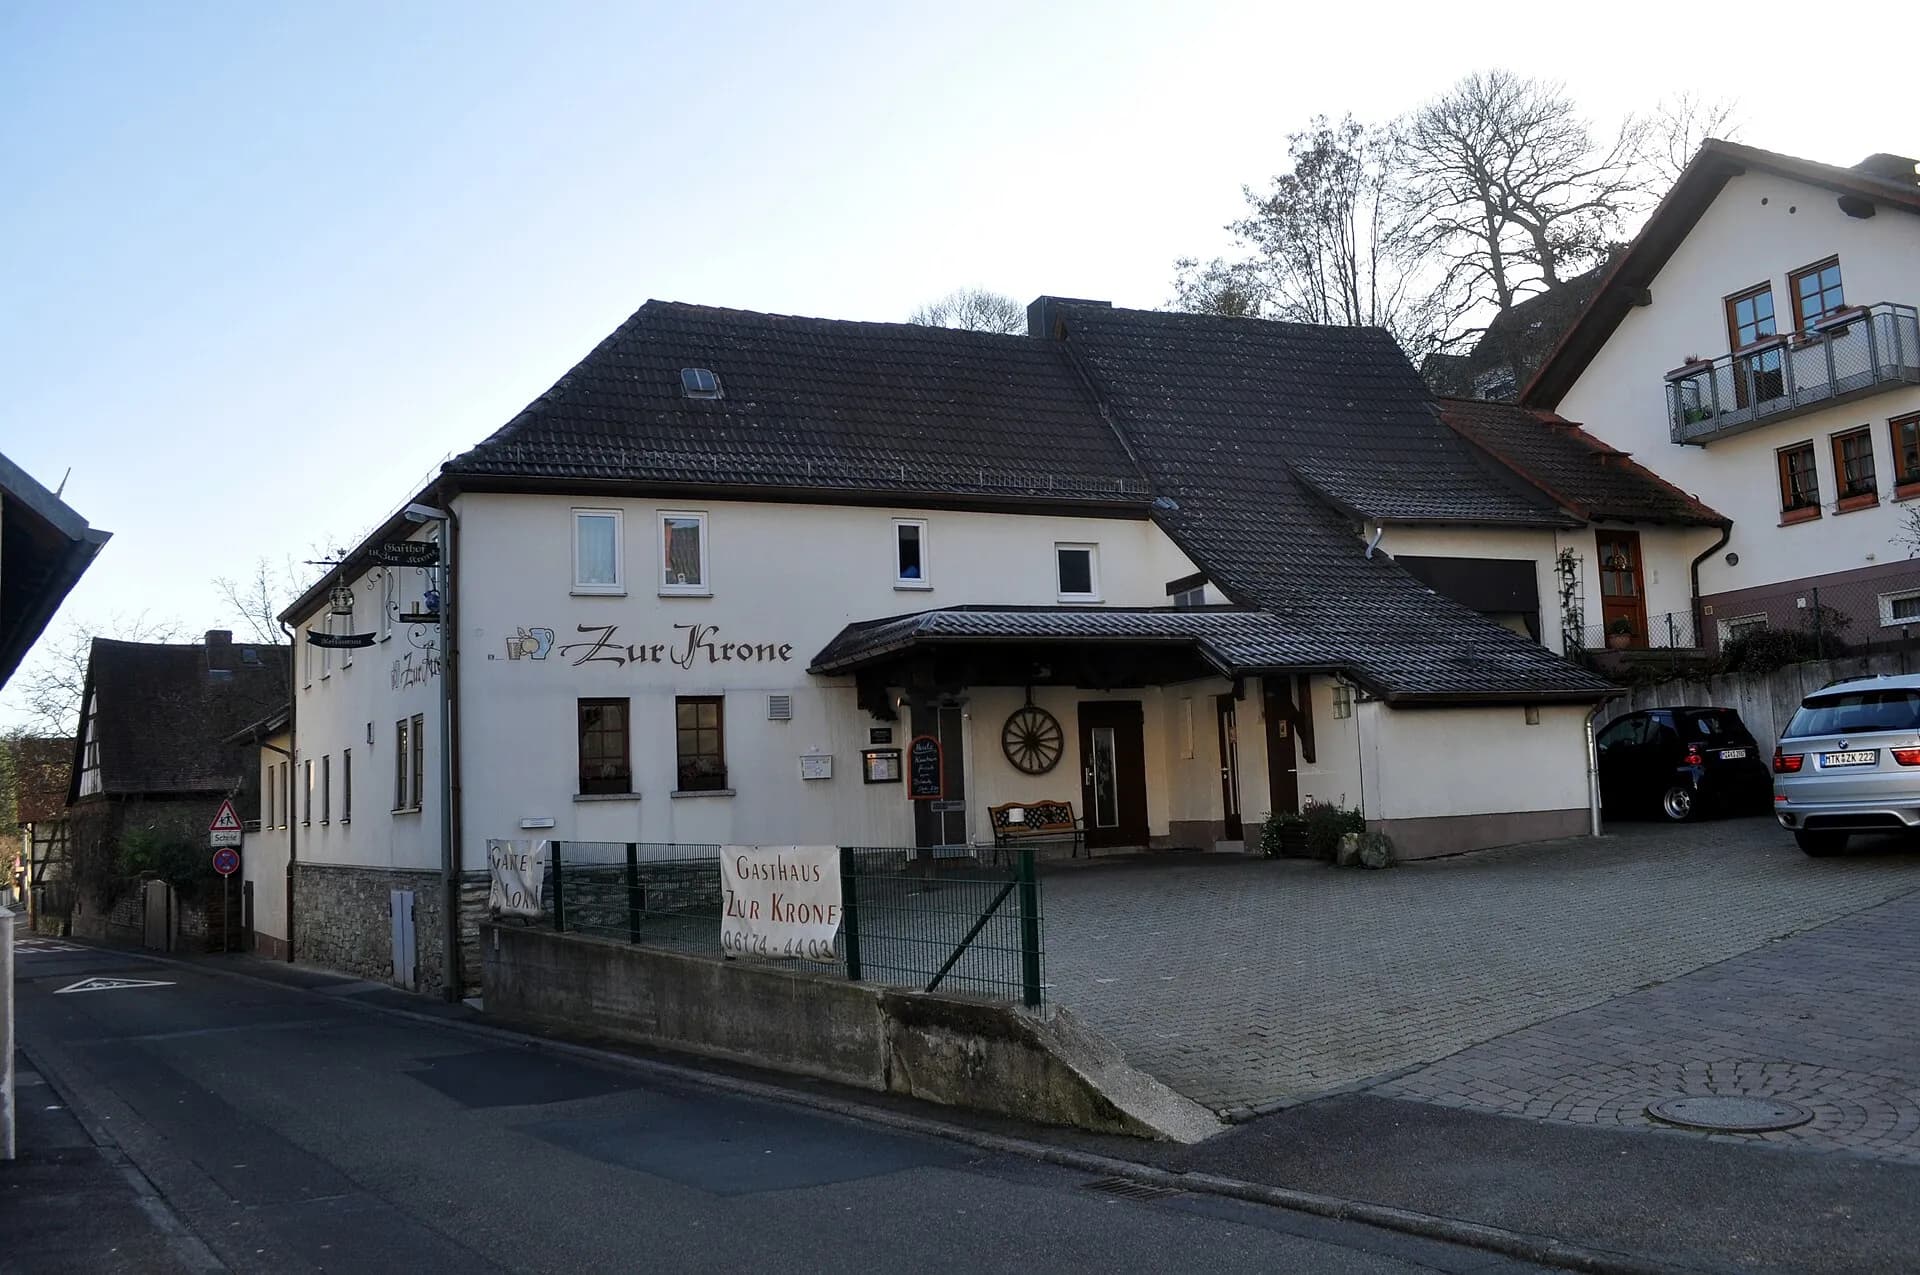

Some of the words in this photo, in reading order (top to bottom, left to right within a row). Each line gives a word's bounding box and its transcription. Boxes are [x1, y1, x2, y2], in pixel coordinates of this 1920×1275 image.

[558, 624, 665, 667] Zur
[670, 624, 793, 670] Krone
[1846, 752, 1857, 763] ZK
[1859, 751, 1874, 762] 222
